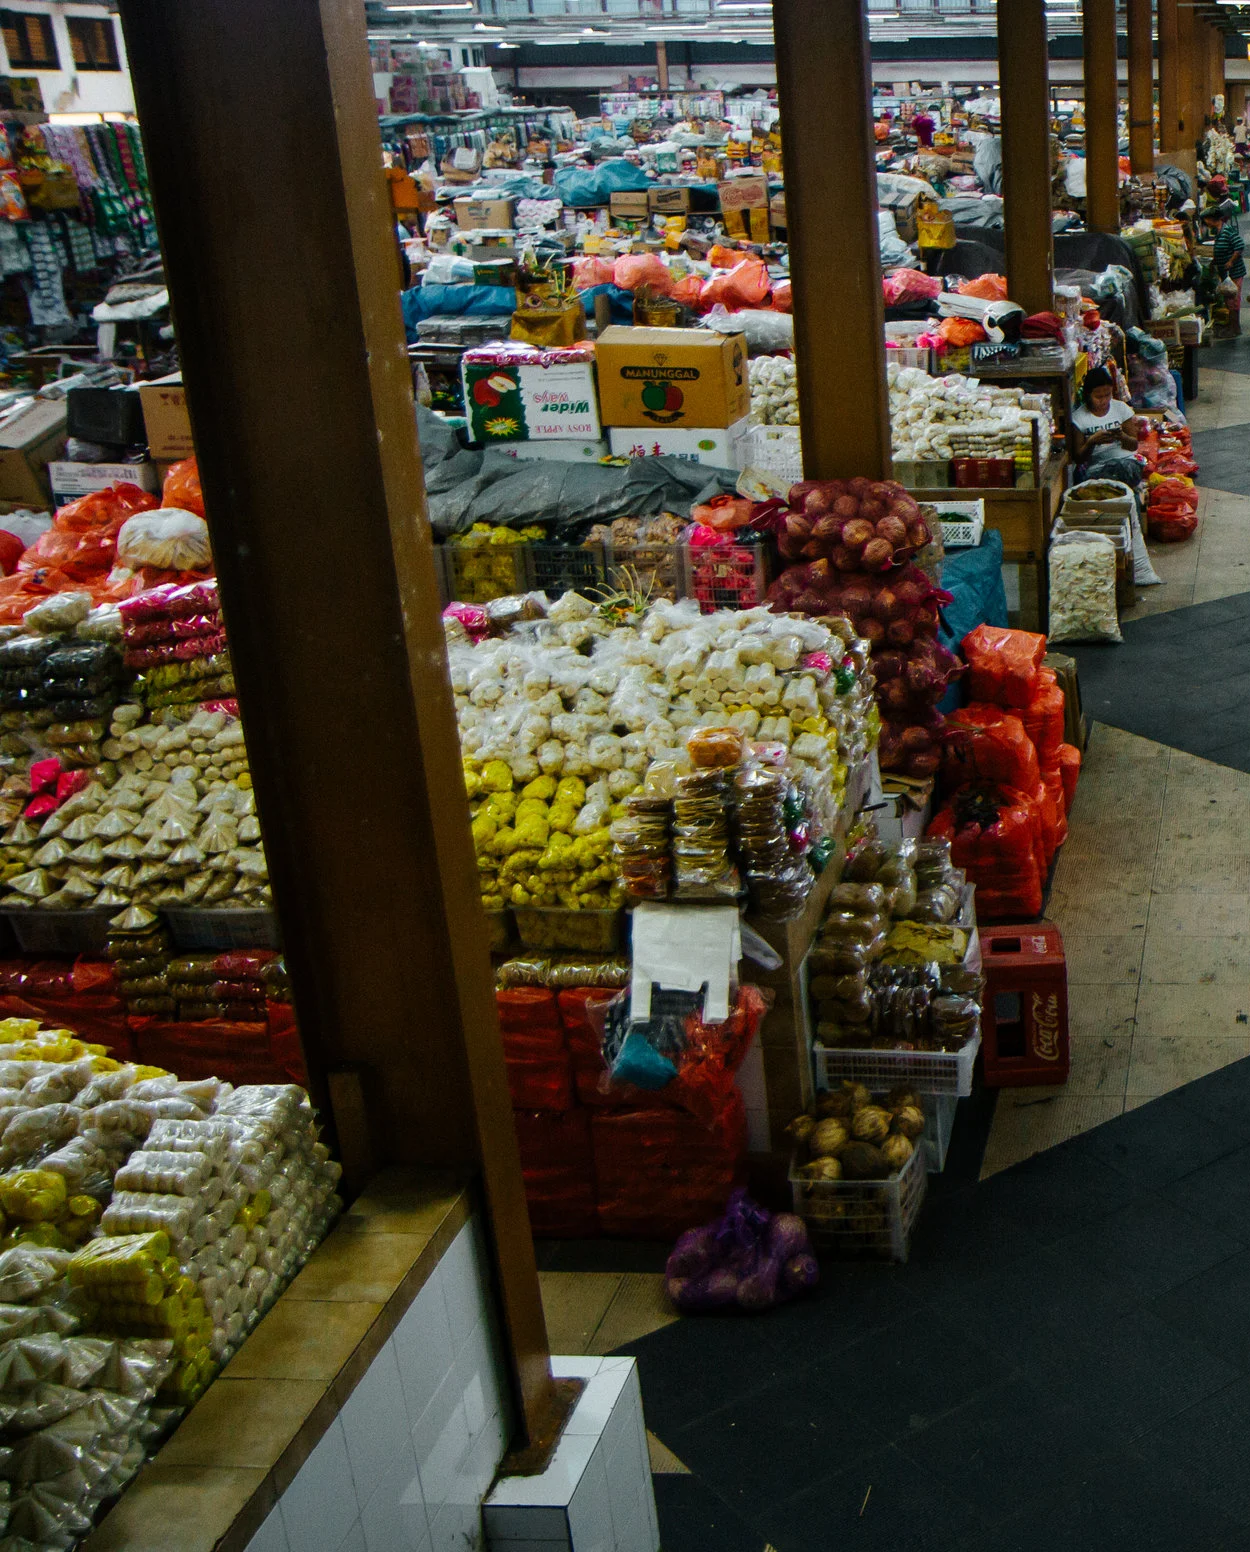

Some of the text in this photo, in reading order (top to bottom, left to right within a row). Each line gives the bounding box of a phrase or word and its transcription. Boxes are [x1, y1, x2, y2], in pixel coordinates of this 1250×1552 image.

[625, 369, 697, 379] MANUNGGAL
[533, 390, 569, 404] ways
[541, 400, 589, 414] Wider
[534, 424, 592, 434] ROSY APPLE
